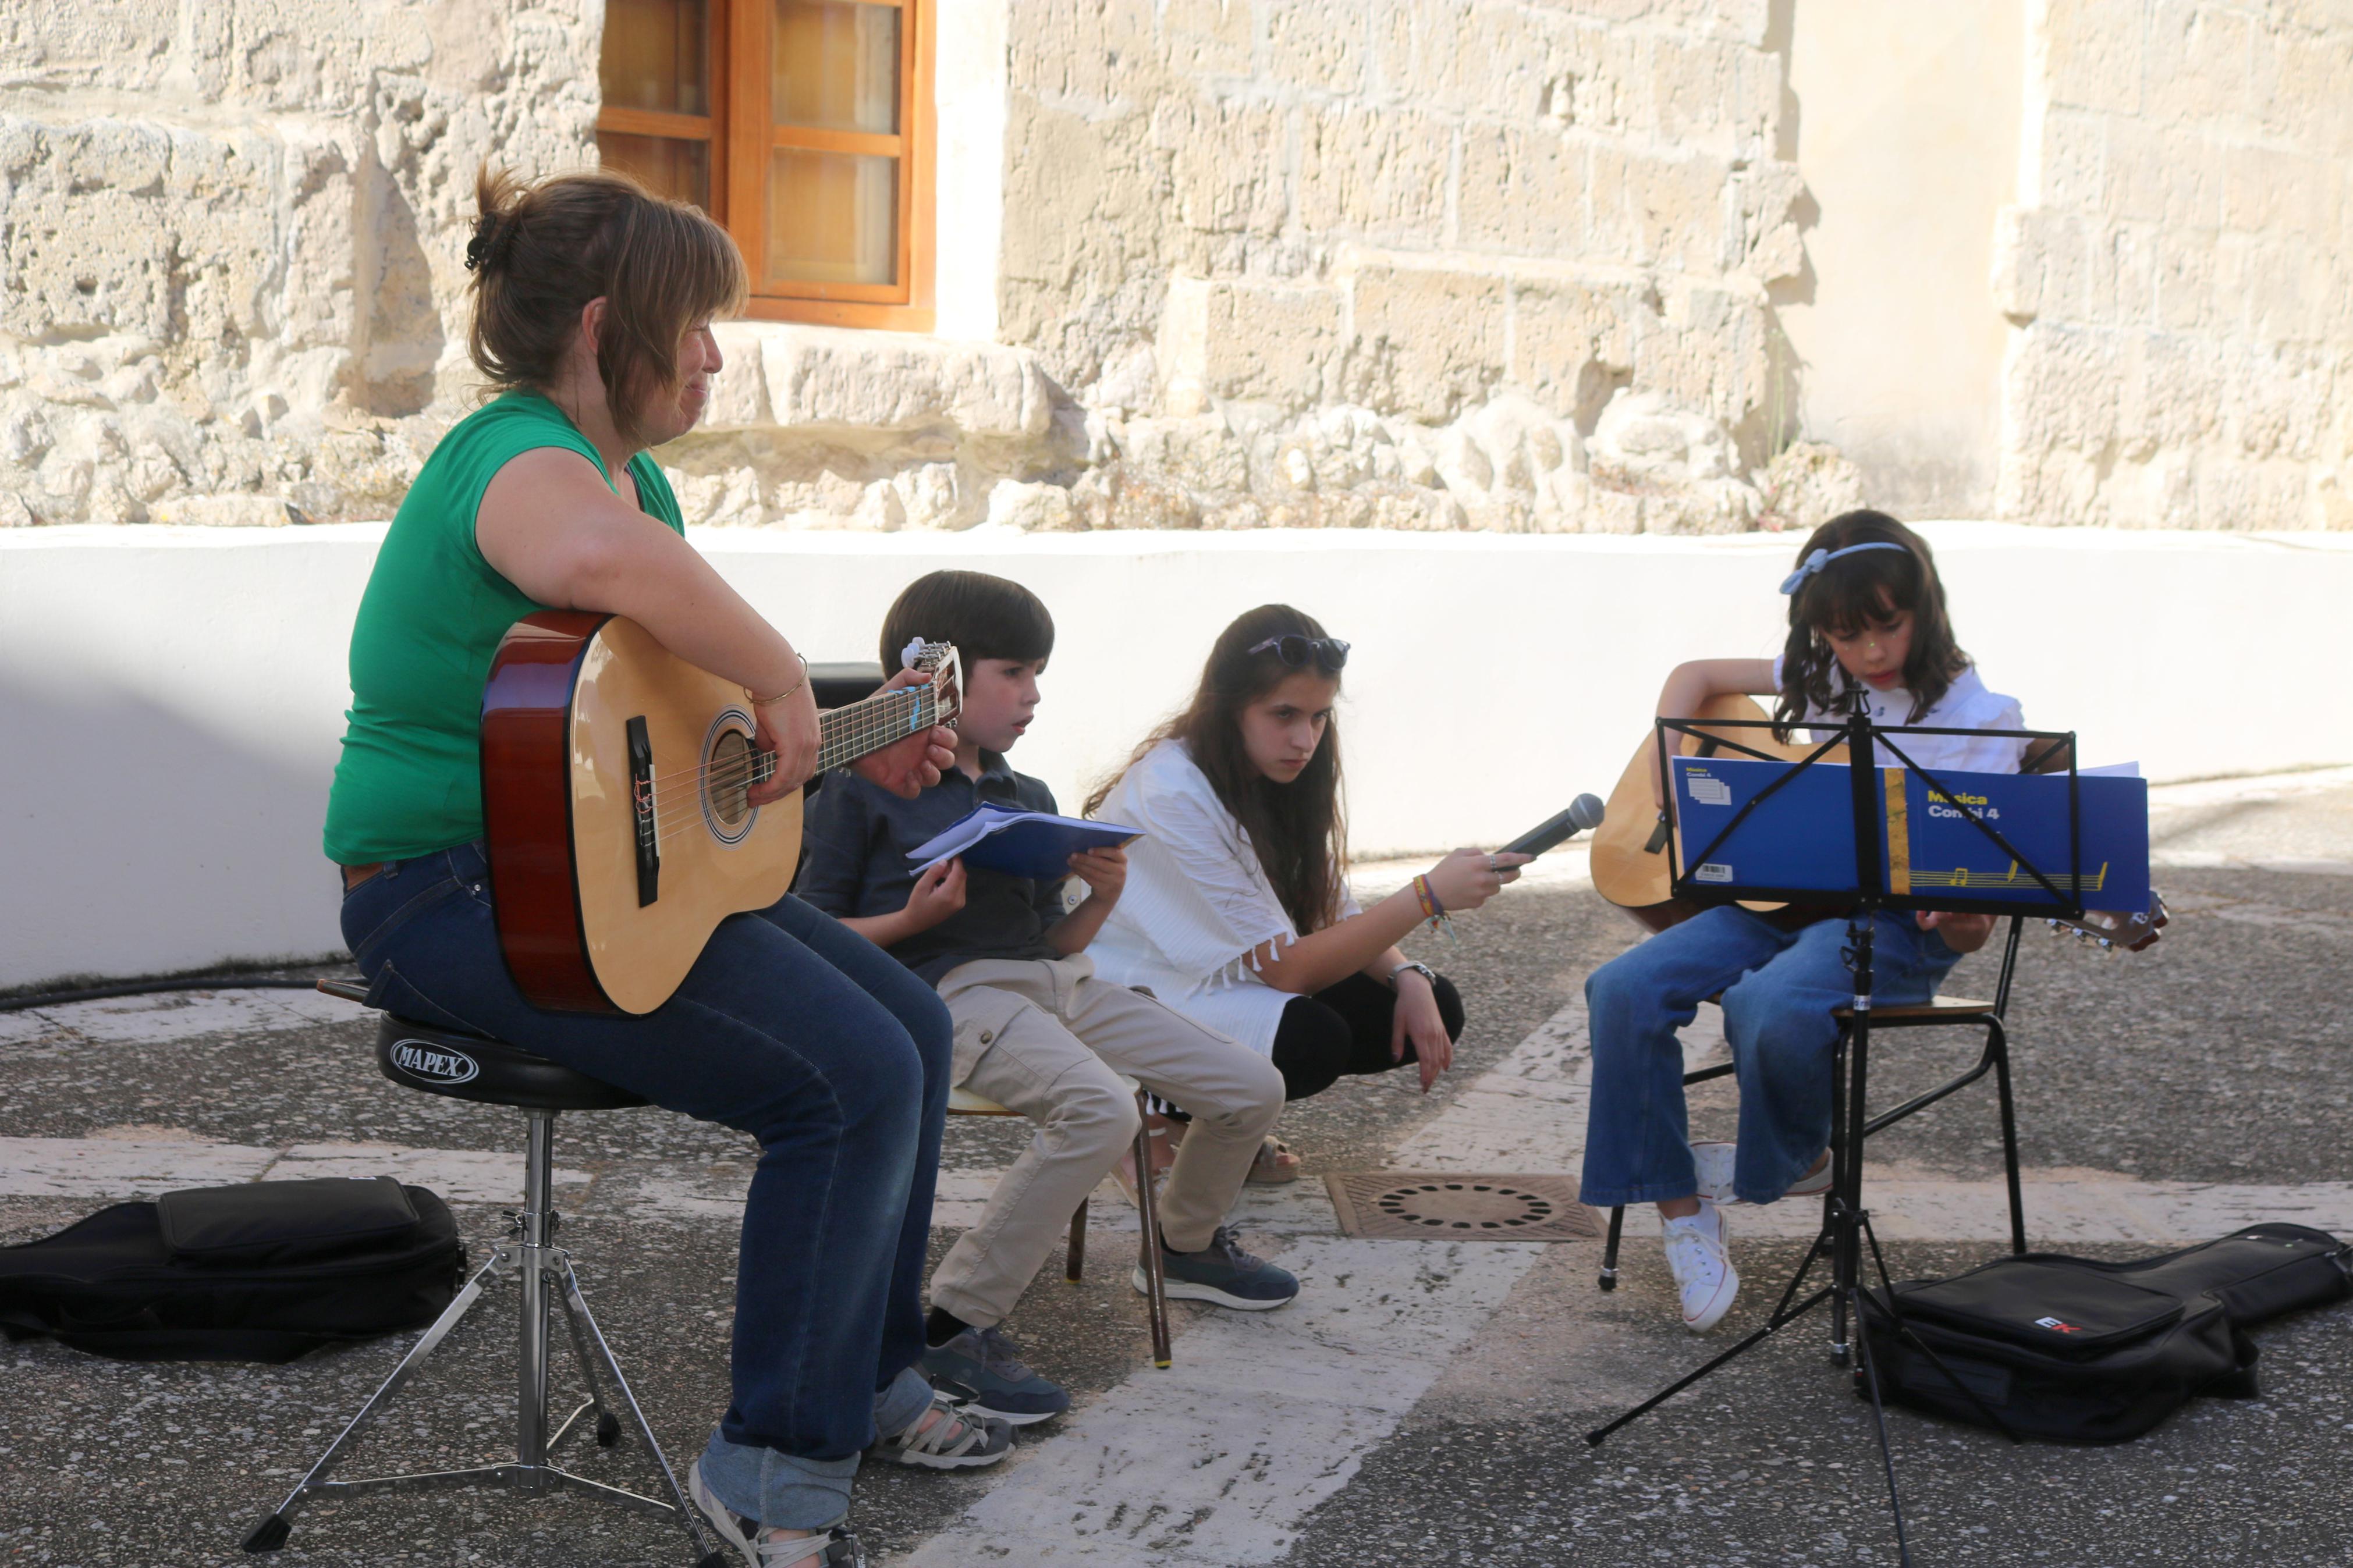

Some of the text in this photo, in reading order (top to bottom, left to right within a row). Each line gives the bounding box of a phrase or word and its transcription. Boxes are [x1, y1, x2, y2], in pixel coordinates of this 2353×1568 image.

[1928, 790, 1988, 805] Msica
[1986, 808, 2000, 820] 4
[398, 1046, 464, 1077] MAPEX
